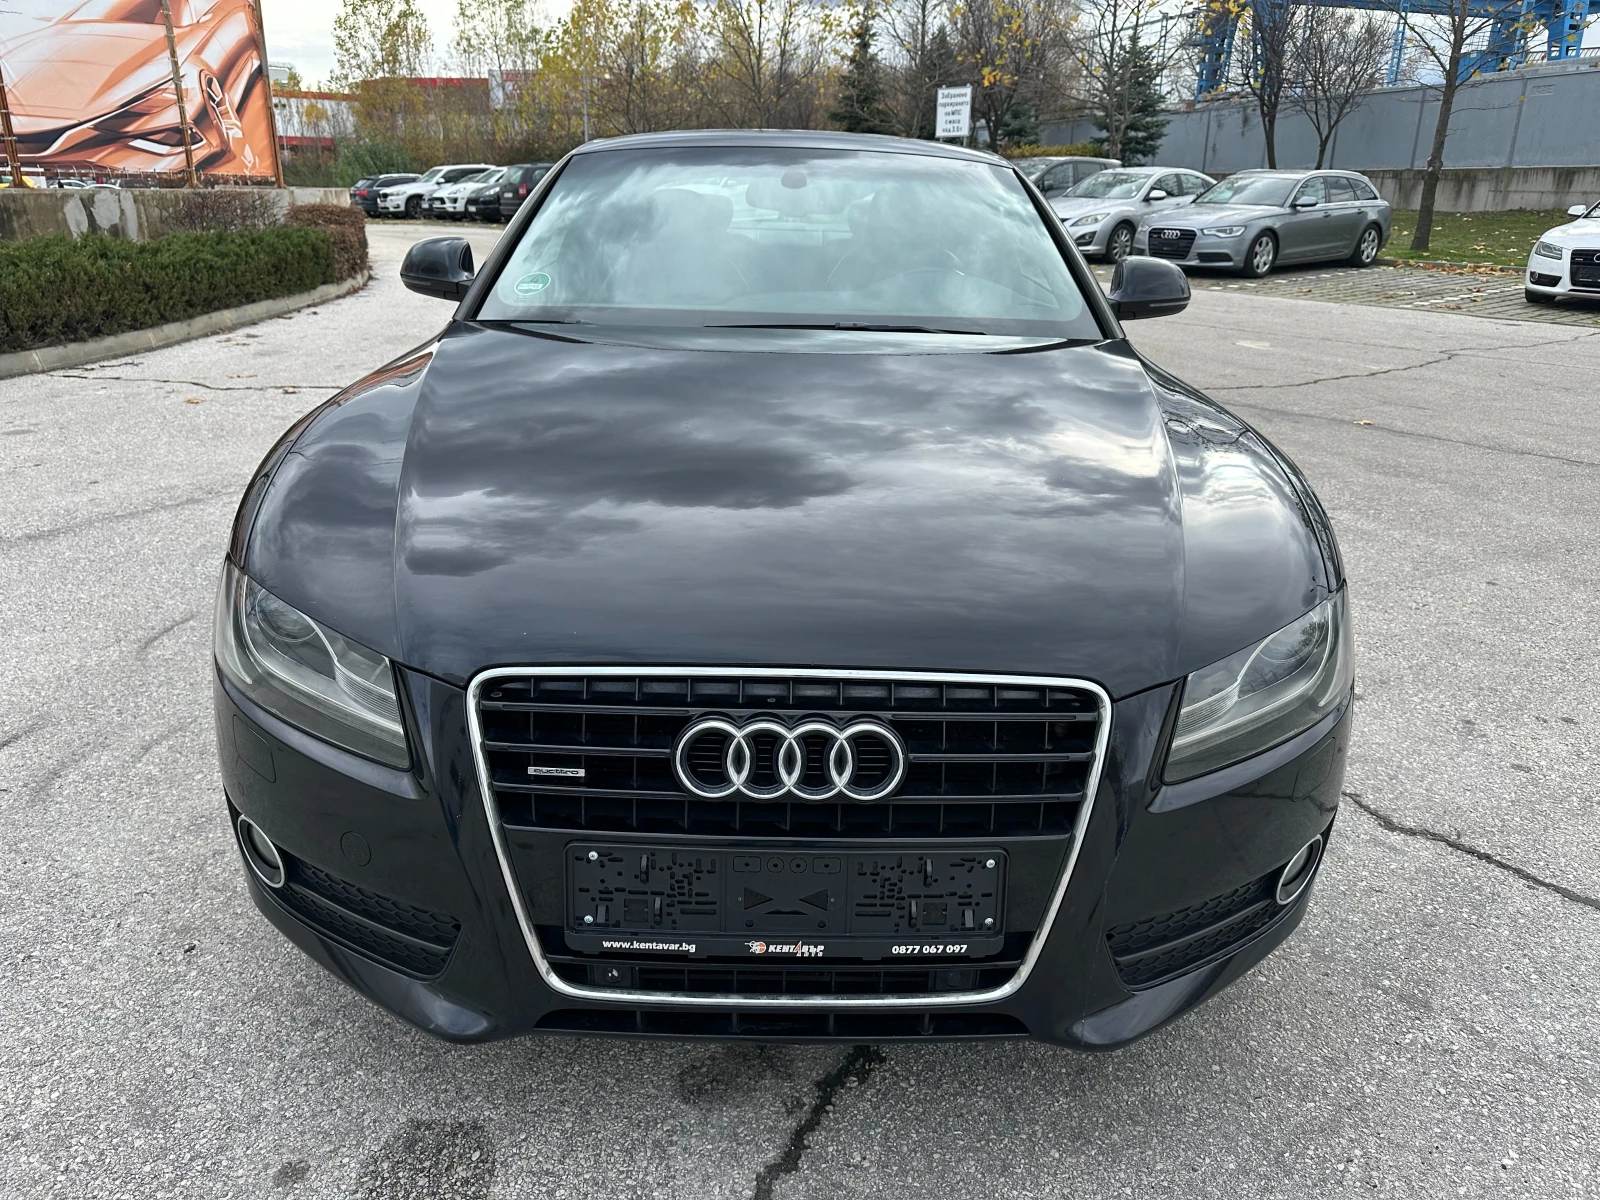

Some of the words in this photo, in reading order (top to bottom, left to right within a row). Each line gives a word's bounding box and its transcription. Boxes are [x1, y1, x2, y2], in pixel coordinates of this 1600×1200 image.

[602, 941, 696, 953] www.kentavar.bg
[891, 945, 920, 954] 0877
[922, 945, 944, 954] 067
[946, 944, 968, 953] 097
